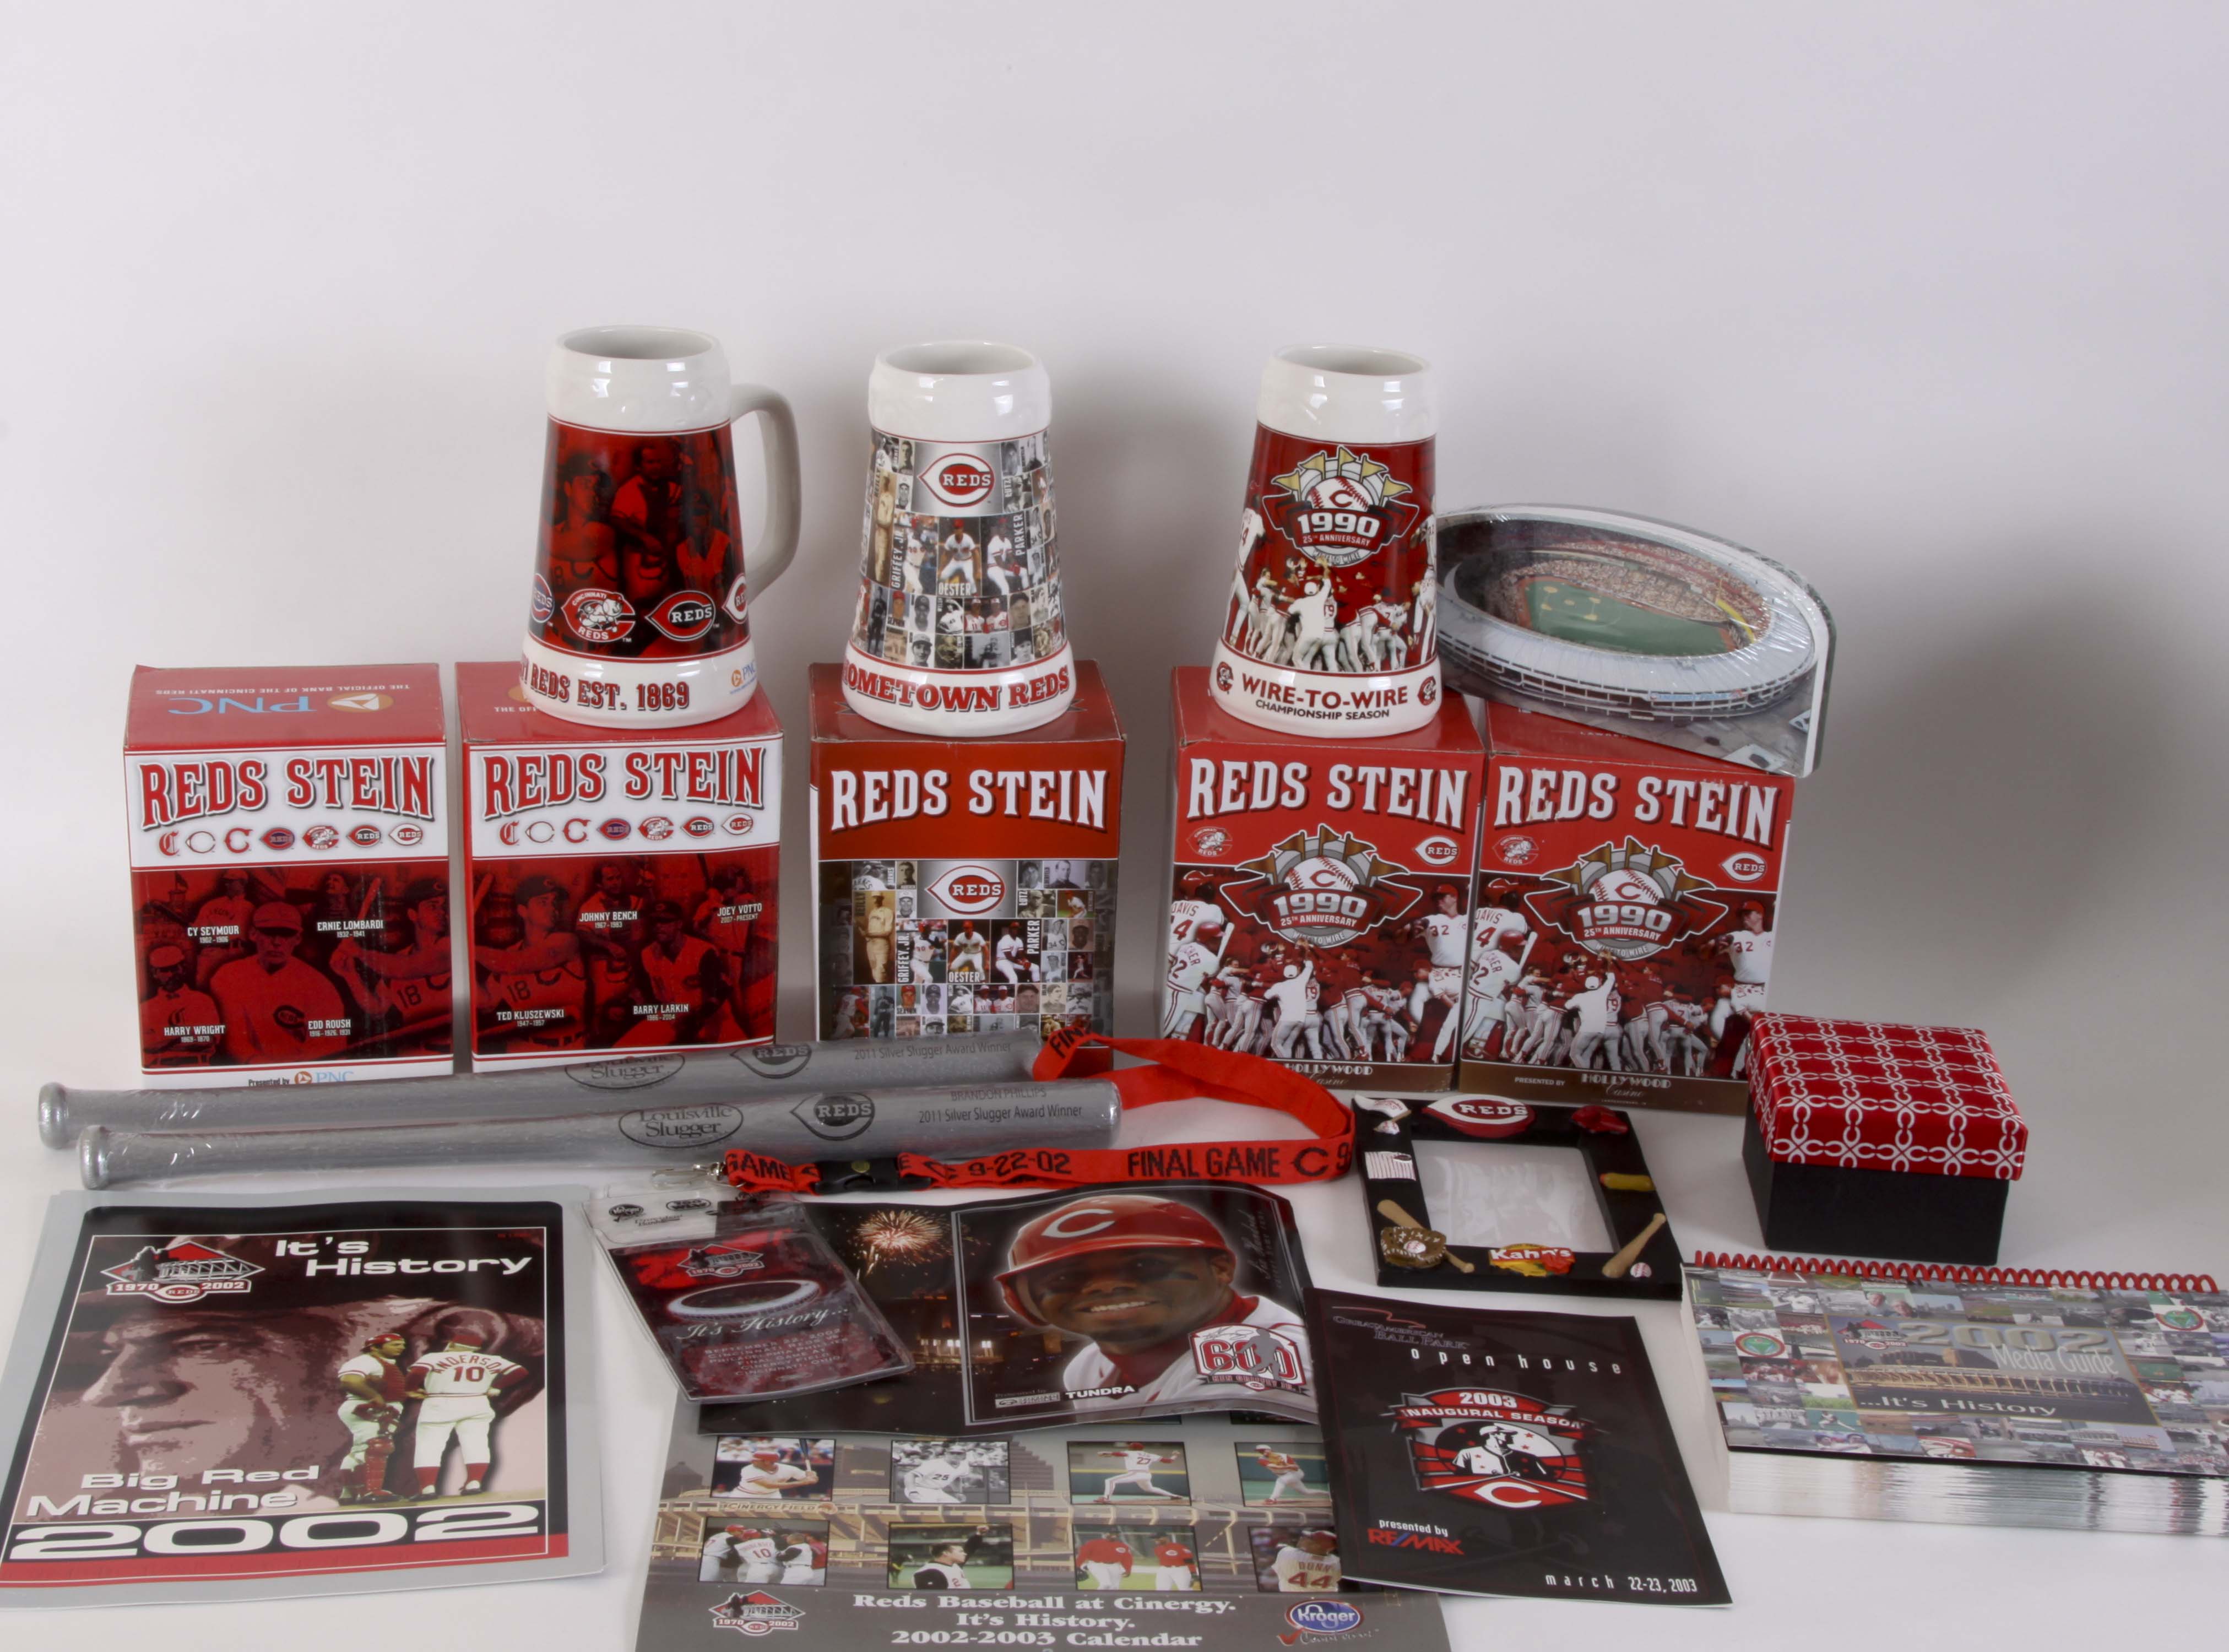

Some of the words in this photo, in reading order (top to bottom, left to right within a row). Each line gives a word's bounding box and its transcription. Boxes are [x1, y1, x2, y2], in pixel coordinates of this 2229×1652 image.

[942, 473, 992, 487] REDS
[1297, 512, 1380, 538] 1990
[1012, 513, 1024, 557] PARKER
[1320, 534, 1371, 547] ANNIVERSARY
[572, 591, 607, 606] CINCINNATI
[938, 582, 971, 597] OESTER
[671, 606, 713, 624] REDS
[577, 626, 609, 641] REDS
[530, 664, 571, 703] REDS
[577, 678, 627, 711] EST.
[636, 681, 690, 712] 1869
[1008, 664, 1070, 707] REDS
[1241, 672, 1408, 709] WIRE-TO-WIRE
[168, 696, 317, 714] PNC
[1255, 699, 1343, 721] CHAMPIONSHIP
[1346, 709, 1390, 721] SEASON
[482, 751, 605, 821] REDS
[624, 746, 766, 810] STEIN
[138, 759, 267, 831] REDS
[285, 755, 435, 822] STEIN
[830, 769, 950, 832] REDS
[968, 769, 1108, 832] STEIN
[1186, 758, 1311, 822] REDS
[1327, 763, 1470, 833] STEIN
[1494, 766, 1619, 827] REDS
[1634, 776, 1781, 850] STEIN
[1427, 846, 1458, 856] REDS
[1734, 861, 1766, 873] REDS
[952, 884, 1001, 896] REDS
[1019, 890, 1028, 906] LUTZ
[718, 905, 737, 917] JOEY
[739, 902, 762, 914] VOTTO
[1273, 892, 1368, 919] 1990
[317, 921, 341, 931] ERNIE
[343, 920, 384, 930] LOMBARDI
[579, 912, 611, 922] JOHNNY
[612, 911, 638, 921] BENCH
[1300, 914, 1358, 928] ANNIVERSARY
[1577, 904, 1672, 932] 1990
[187, 927, 198, 937] CY
[200, 925, 240, 936] SEYMOUR
[1027, 920, 1040, 955] PARKER
[1431, 925, 1450, 937] 32
[1603, 926, 1661, 941] ANNIVERSARY
[1733, 941, 1754, 953] 32
[948, 971, 980, 983] OESTER
[497, 1011, 512, 1021] TED
[514, 1009, 565, 1021] KLUSZEWSKI
[633, 1005, 658, 1015] BARRY
[660, 1003, 689, 1014] LARKIN
[164, 1026, 190, 1036] HARRY
[193, 1025, 226, 1036] WRIGHT
[308, 1020, 323, 1030] EDD
[326, 1019, 351, 1029] ROUSH
[854, 1049, 876, 1060] 2011
[879, 1047, 904, 1059] Silver
[907, 1044, 943, 1058] Slugger
[945, 1043, 975, 1055] Award
[977, 1041, 1011, 1053] Winner
[590, 1063, 665, 1081] Slugger
[1515, 1076, 1554, 1086] PRESENTED
[1581, 1073, 1672, 1089] HOLLYWOOD
[951, 1089, 1001, 1102] BRANDON
[1003, 1087, 1046, 1099] PHILLIPS
[639, 1106, 733, 1123] Louisville
[817, 1104, 872, 1118] REDS
[919, 1111, 941, 1124] 2011
[945, 1109, 971, 1122] Silver
[973, 1107, 1011, 1123] Slugger
[1014, 1106, 1045, 1119] Award
[1048, 1104, 1082, 1117] Winner
[1460, 1103, 1528, 1117] REDS
[646, 1119, 720, 1139] Slugger
[1127, 1149, 1200, 1178] FINAL
[1206, 1147, 1281, 1178] GAME
[275, 1238, 370, 1258] It's
[306, 1256, 533, 1277] History
[115, 1283, 159, 1292] 1970
[202, 1281, 244, 1290] 2002
[676, 1323, 723, 1340] It's
[1899, 1322, 2113, 1355] 2002
[432, 1353, 505, 1377] ANDERSON
[1991, 1342, 2054, 1372] Media
[2057, 1346, 2119, 1375] Guide
[453, 1365, 485, 1384] 10
[1065, 1385, 1136, 1400] TUNDRA
[1459, 1391, 1517, 1408] 2003
[1940, 1398, 2056, 1417] History
[1401, 1406, 1504, 1419] INAUGURAL
[1510, 1412, 1585, 1429] SEASON
[80, 1471, 181, 1492] Big
[201, 1465, 321, 1485] Red
[25, 1489, 299, 1517] Machine
[9, 1503, 540, 1560] 2002
[1379, 1519, 1431, 1534] presented
[1434, 1525, 1449, 1537] by
[1368, 1529, 1466, 1556] RE/MAX
[1287, 1570, 1332, 1589] 44
[1545, 1573, 1614, 1590] march
[1668, 1578, 1697, 1593] 2003
[853, 1594, 927, 1608] Reds
[937, 1595, 1065, 1609] Baseball
[1076, 1599, 1112, 1610] at
[1122, 1596, 1236, 1614] Cinergy.
[769, 1619, 794, 1628] 2002
[956, 1613, 1005, 1626] It's
[1015, 1613, 1135, 1631] History.
[1297, 1604, 1357, 1628] Kroger
[891, 1631, 1056, 1645] 2002-2003
[1066, 1632, 1202, 1646] Calendar
